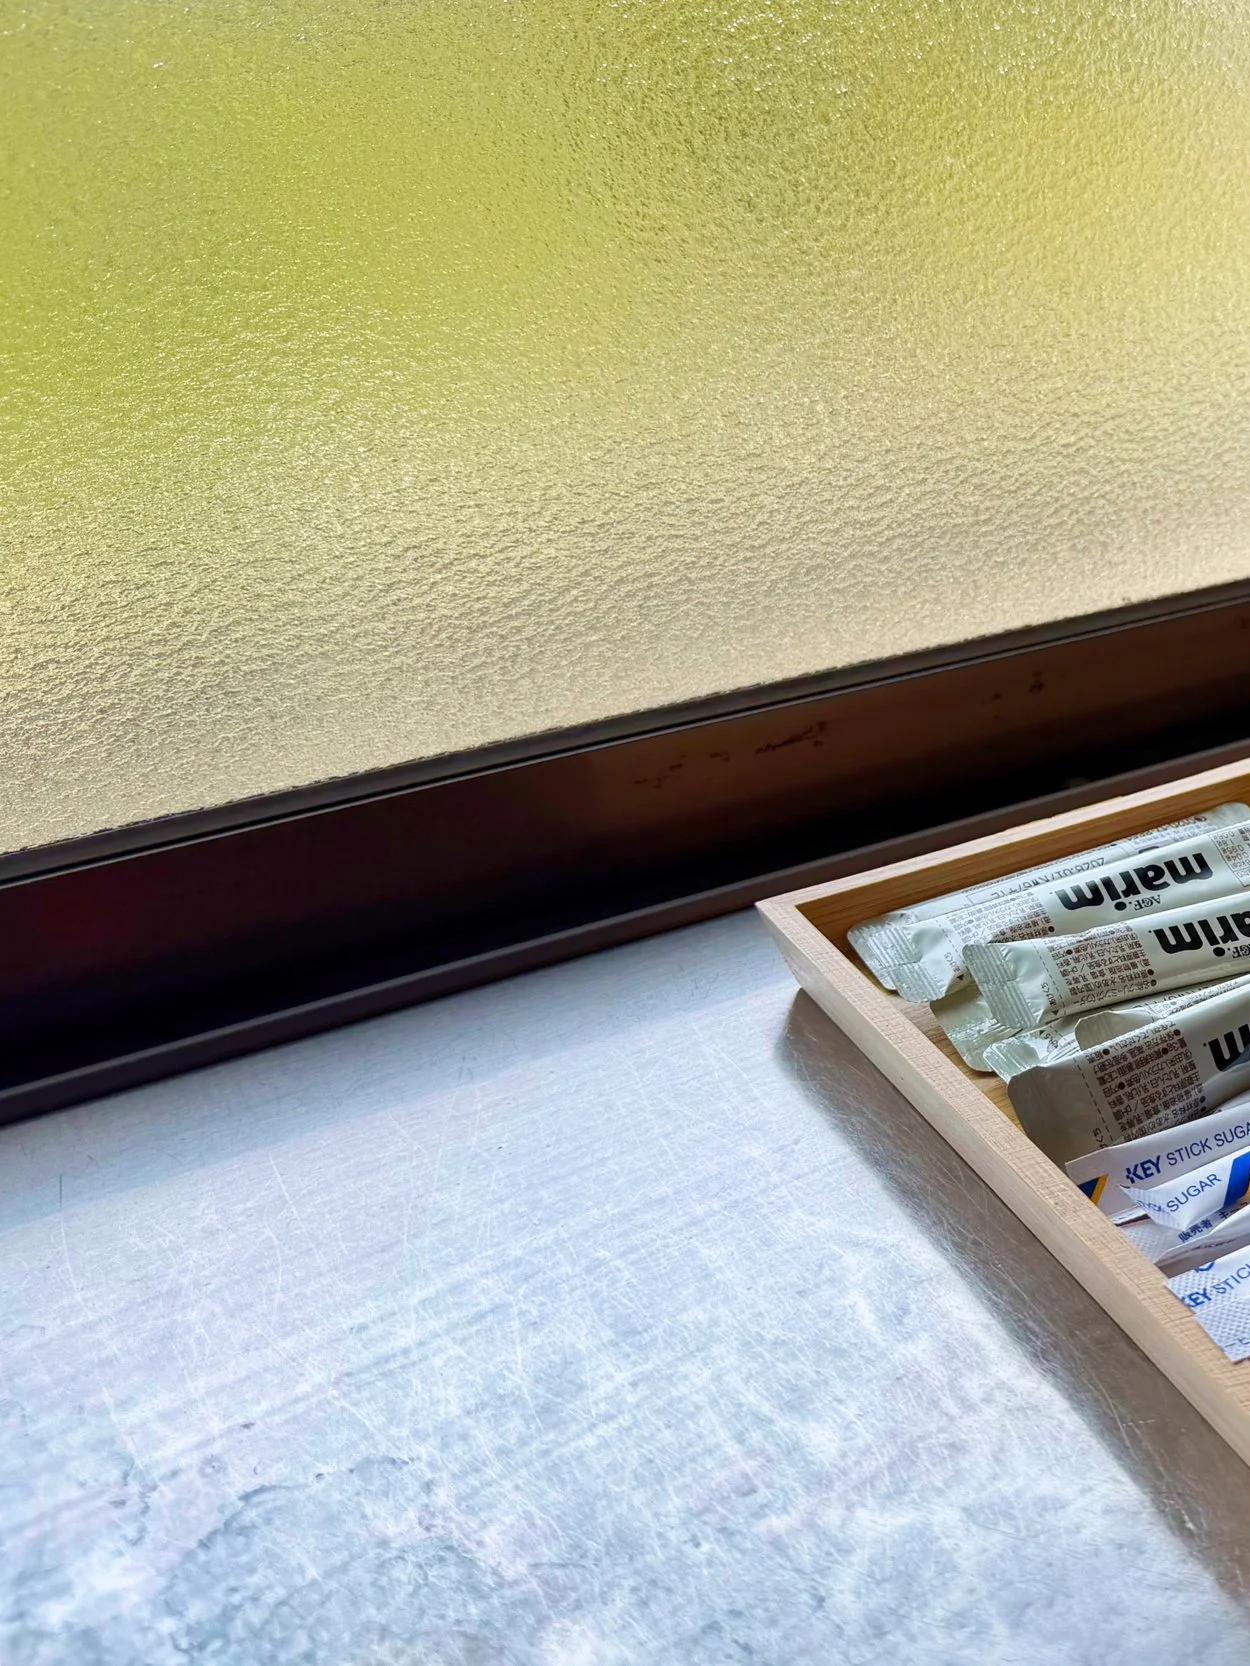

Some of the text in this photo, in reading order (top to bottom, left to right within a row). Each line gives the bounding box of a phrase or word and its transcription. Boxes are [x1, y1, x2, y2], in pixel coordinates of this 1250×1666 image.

[1123, 1154, 1166, 1185] KEY
[1165, 1138, 1212, 1166] STICK
[1166, 1171, 1222, 1213] SUGAR
[1178, 1218, 1212, 1243] 販売者
